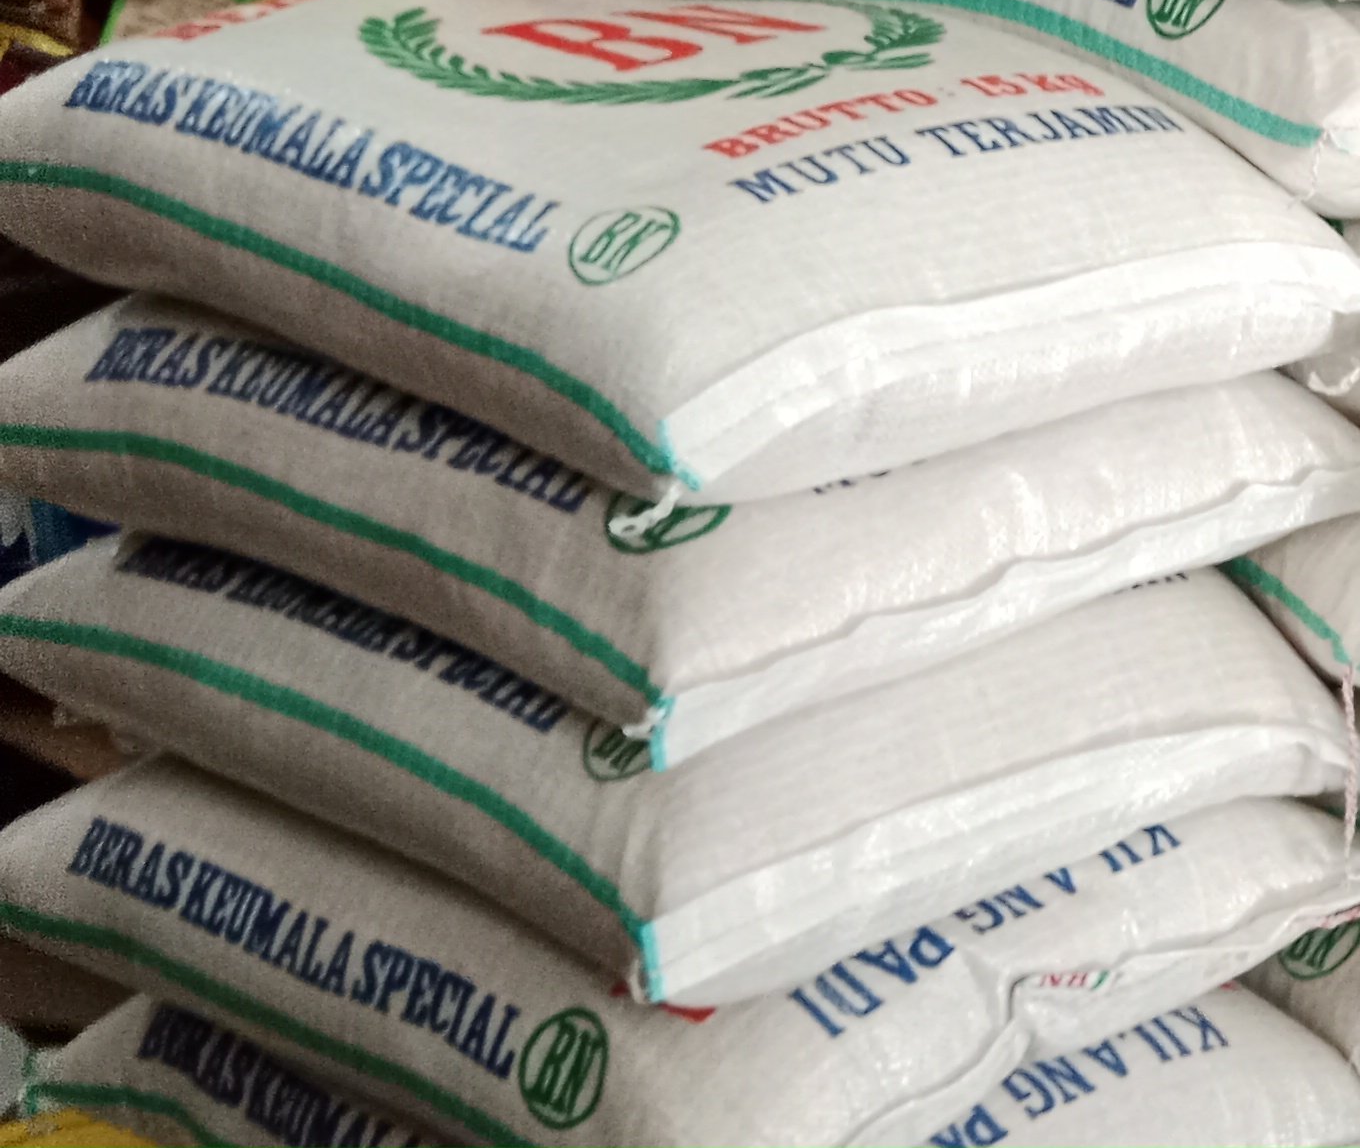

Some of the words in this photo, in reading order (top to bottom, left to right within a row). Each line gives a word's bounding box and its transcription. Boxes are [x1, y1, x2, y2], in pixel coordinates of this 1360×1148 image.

[481, 3, 830, 73] BN
[959, 73, 1018, 102] 15
[1016, 70, 1108, 100] kg
[64, 59, 190, 124] BERAS
[175, 78, 376, 189] KEUMALA
[358, 140, 562, 254] SPECIAL
[726, 133, 910, 205] MUTU
[914, 103, 1188, 158] TERJAMIN
[398, 400, 592, 514] SPECIAL
[67, 816, 196, 912] BERAS
[178, 857, 357, 997] KEUMALA
[349, 938, 523, 1081] SPECIAL
[787, 925, 955, 1038] PADI
[524, 1018, 608, 1121] BN
[1001, 1004, 1231, 1119] KILANG
[929, 1104, 1009, 1148] PA
